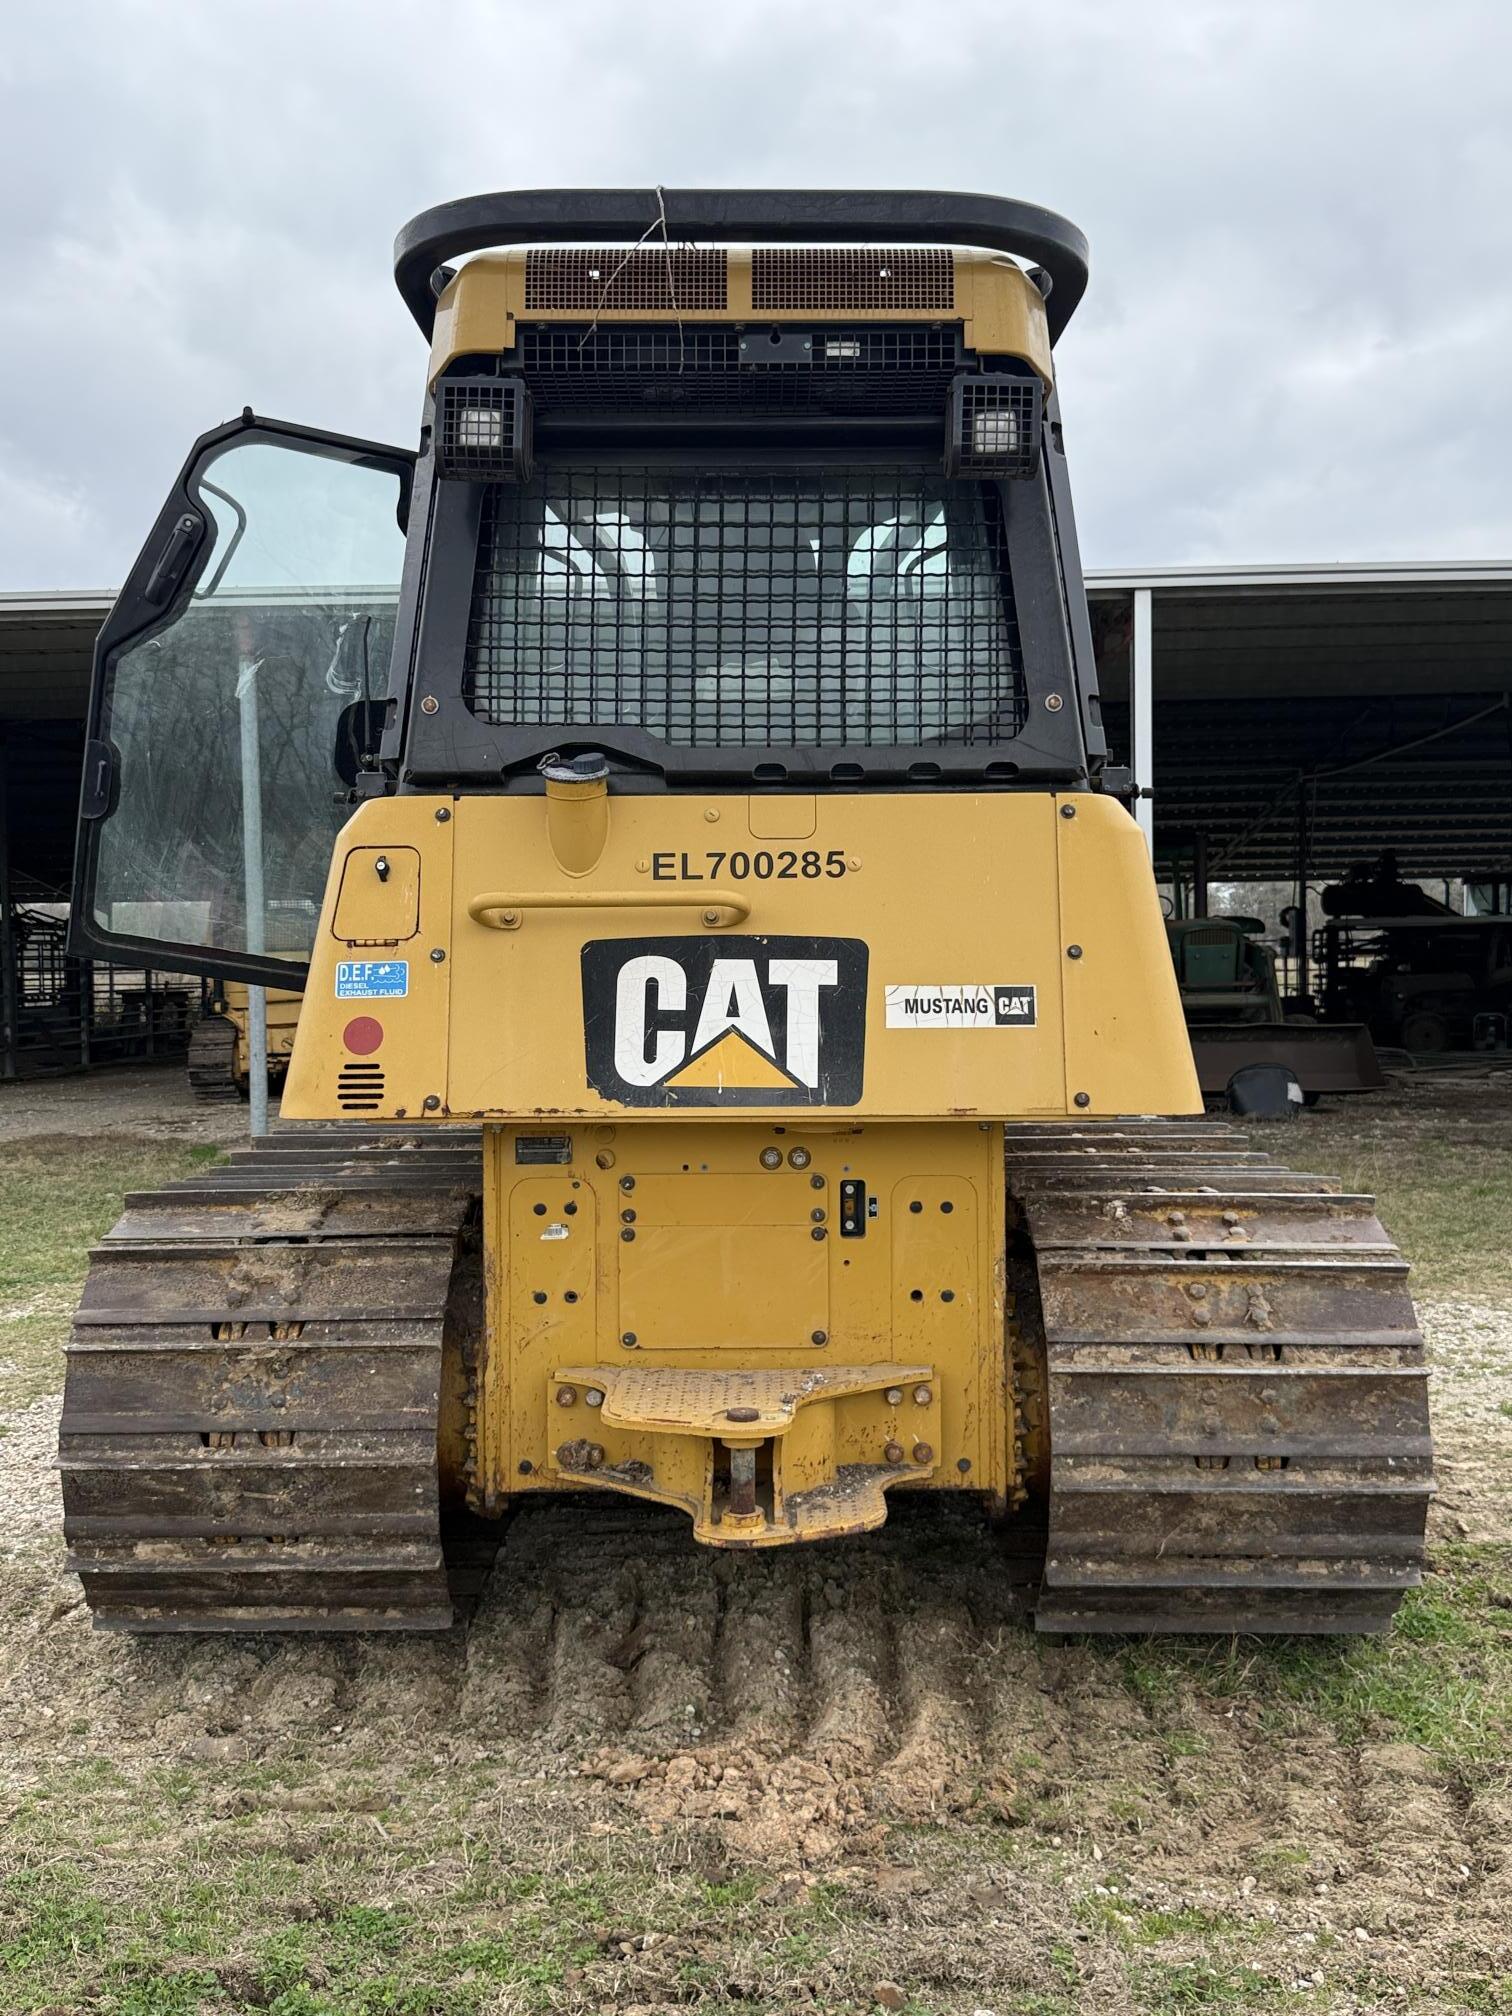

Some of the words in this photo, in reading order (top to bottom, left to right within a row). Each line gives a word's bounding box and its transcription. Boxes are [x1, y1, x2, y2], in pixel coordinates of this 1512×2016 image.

[652, 850, 847, 881] EL700285
[339, 964, 375, 982] D.E.F.
[339, 982, 369, 990] DIESEL
[339, 989, 378, 997] EXHAUST
[379, 988, 404, 996] FLUID
[904, 998, 988, 1014] MUSTANG
[998, 996, 1033, 1015] CAT
[614, 955, 838, 1089] CAT
